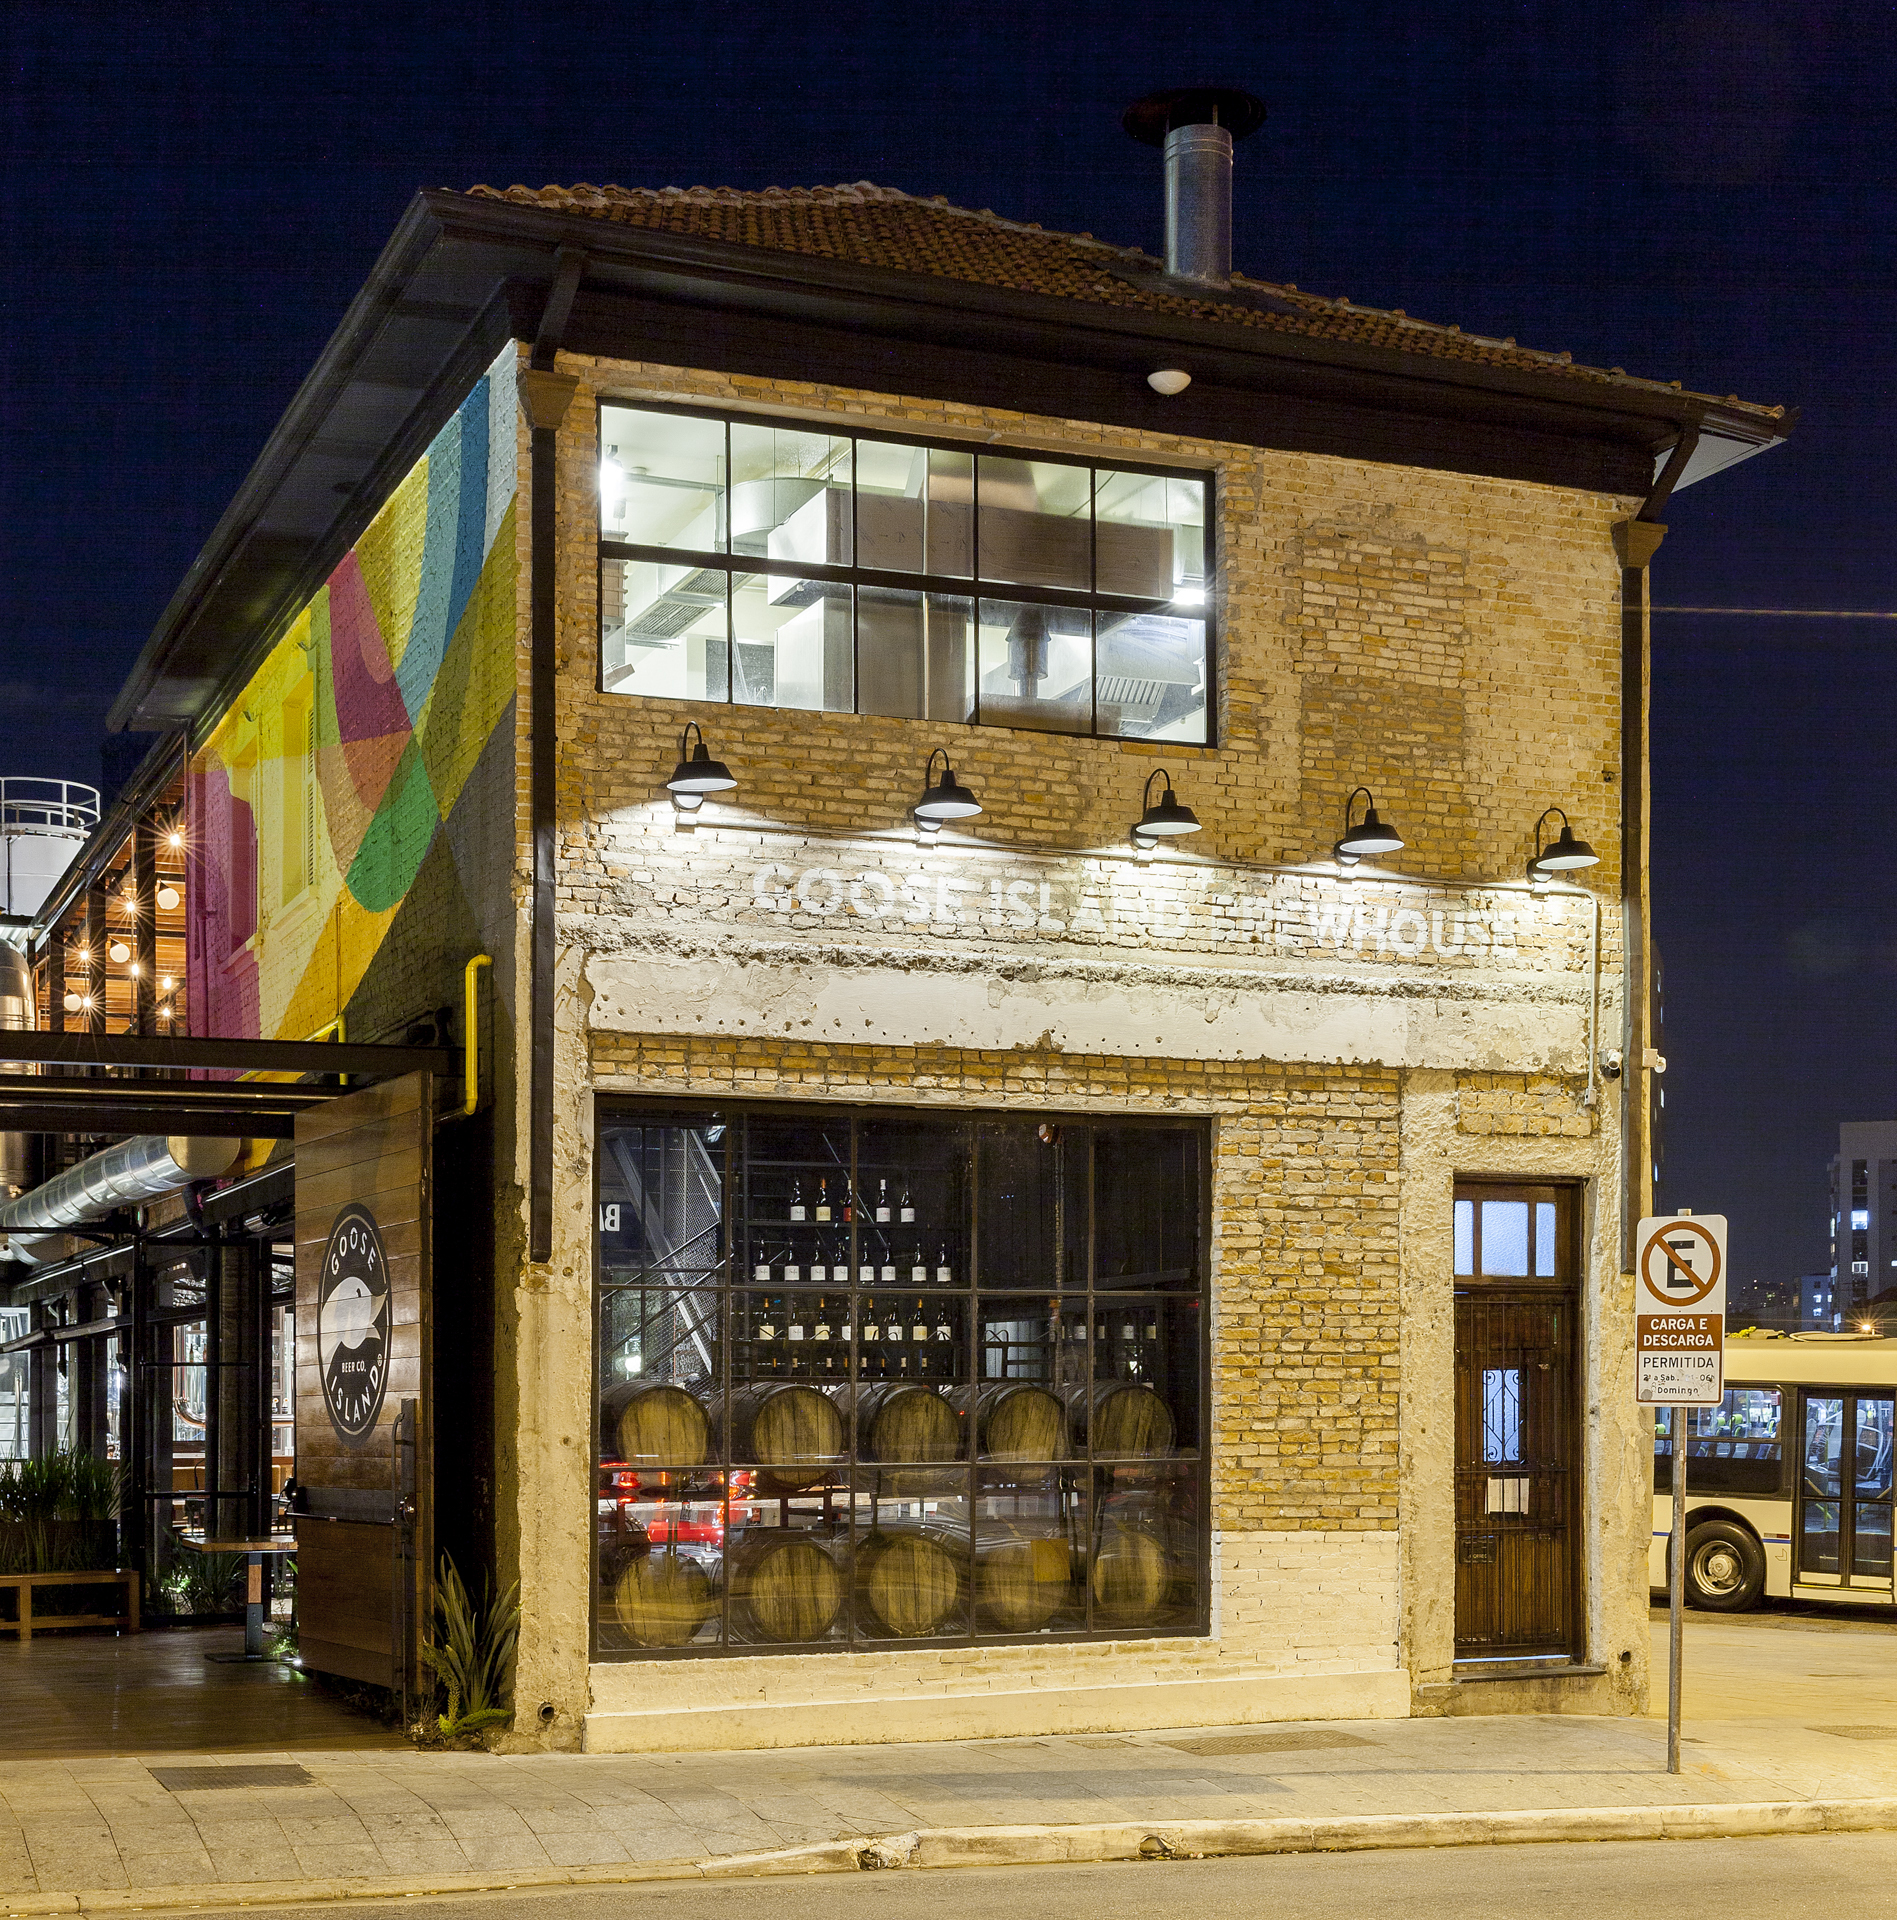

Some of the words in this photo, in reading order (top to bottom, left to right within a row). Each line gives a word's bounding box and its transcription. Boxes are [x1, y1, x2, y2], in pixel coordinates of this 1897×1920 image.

[752, 862, 984, 926] GOOSE
[989, 877, 1192, 940] ISLAND
[331, 1226, 377, 1276] GOOSE
[1666, 1239, 1696, 1289] E
[1650, 1318, 1695, 1330] CARGA
[1699, 1317, 1708, 1330] E
[1643, 1335, 1714, 1346] DESCARGA
[341, 1361, 355, 1373] BEER
[1643, 1357, 1714, 1368] PERMITIDA
[331, 1364, 379, 1424] ISLAND
